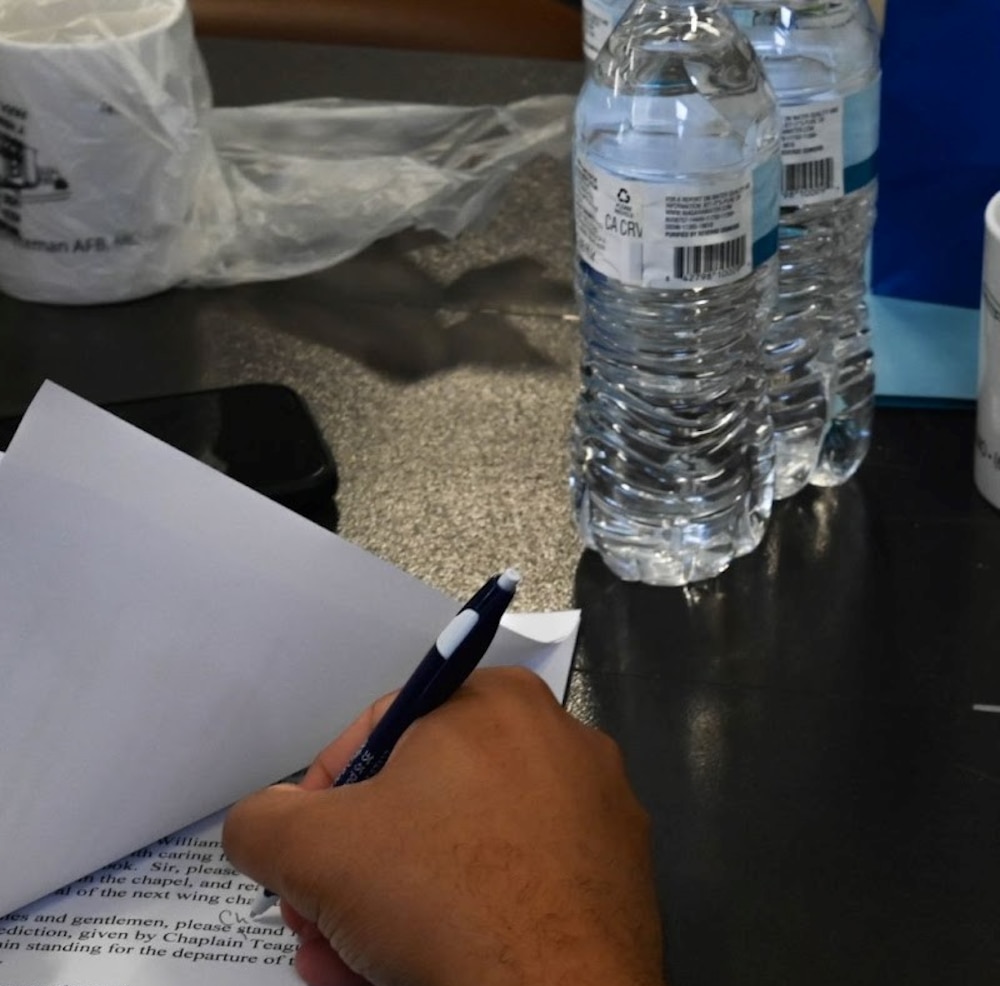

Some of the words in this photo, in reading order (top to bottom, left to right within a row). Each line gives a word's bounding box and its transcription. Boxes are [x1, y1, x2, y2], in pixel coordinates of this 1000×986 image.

[605, 214, 617, 232] CA
[620, 219, 643, 238] CRV
[159, 851, 213, 863] caring
[150, 862, 179, 873] Sir,
[99, 874, 127, 884] the
[132, 877, 192, 888] chapel,
[200, 880, 231, 889] and
[76, 887, 99, 896] of
[100, 888, 127, 898] the
[132, 890, 170, 899] next
[177, 892, 220, 905] wing
[35, 914, 66, 924] and
[71, 915, 168, 928] gentlemen,
[175, 920, 231, 932] please
[237, 926, 284, 936] stand
[78, 930, 128, 941] given
[135, 931, 156, 943] by
[163, 932, 243, 948] Chaplain
[26, 942, 101, 955] standing
[107, 944, 134, 954] for
[140, 946, 167, 956] the
[173, 949, 257, 964] departure
[264, 955, 286, 965] of
